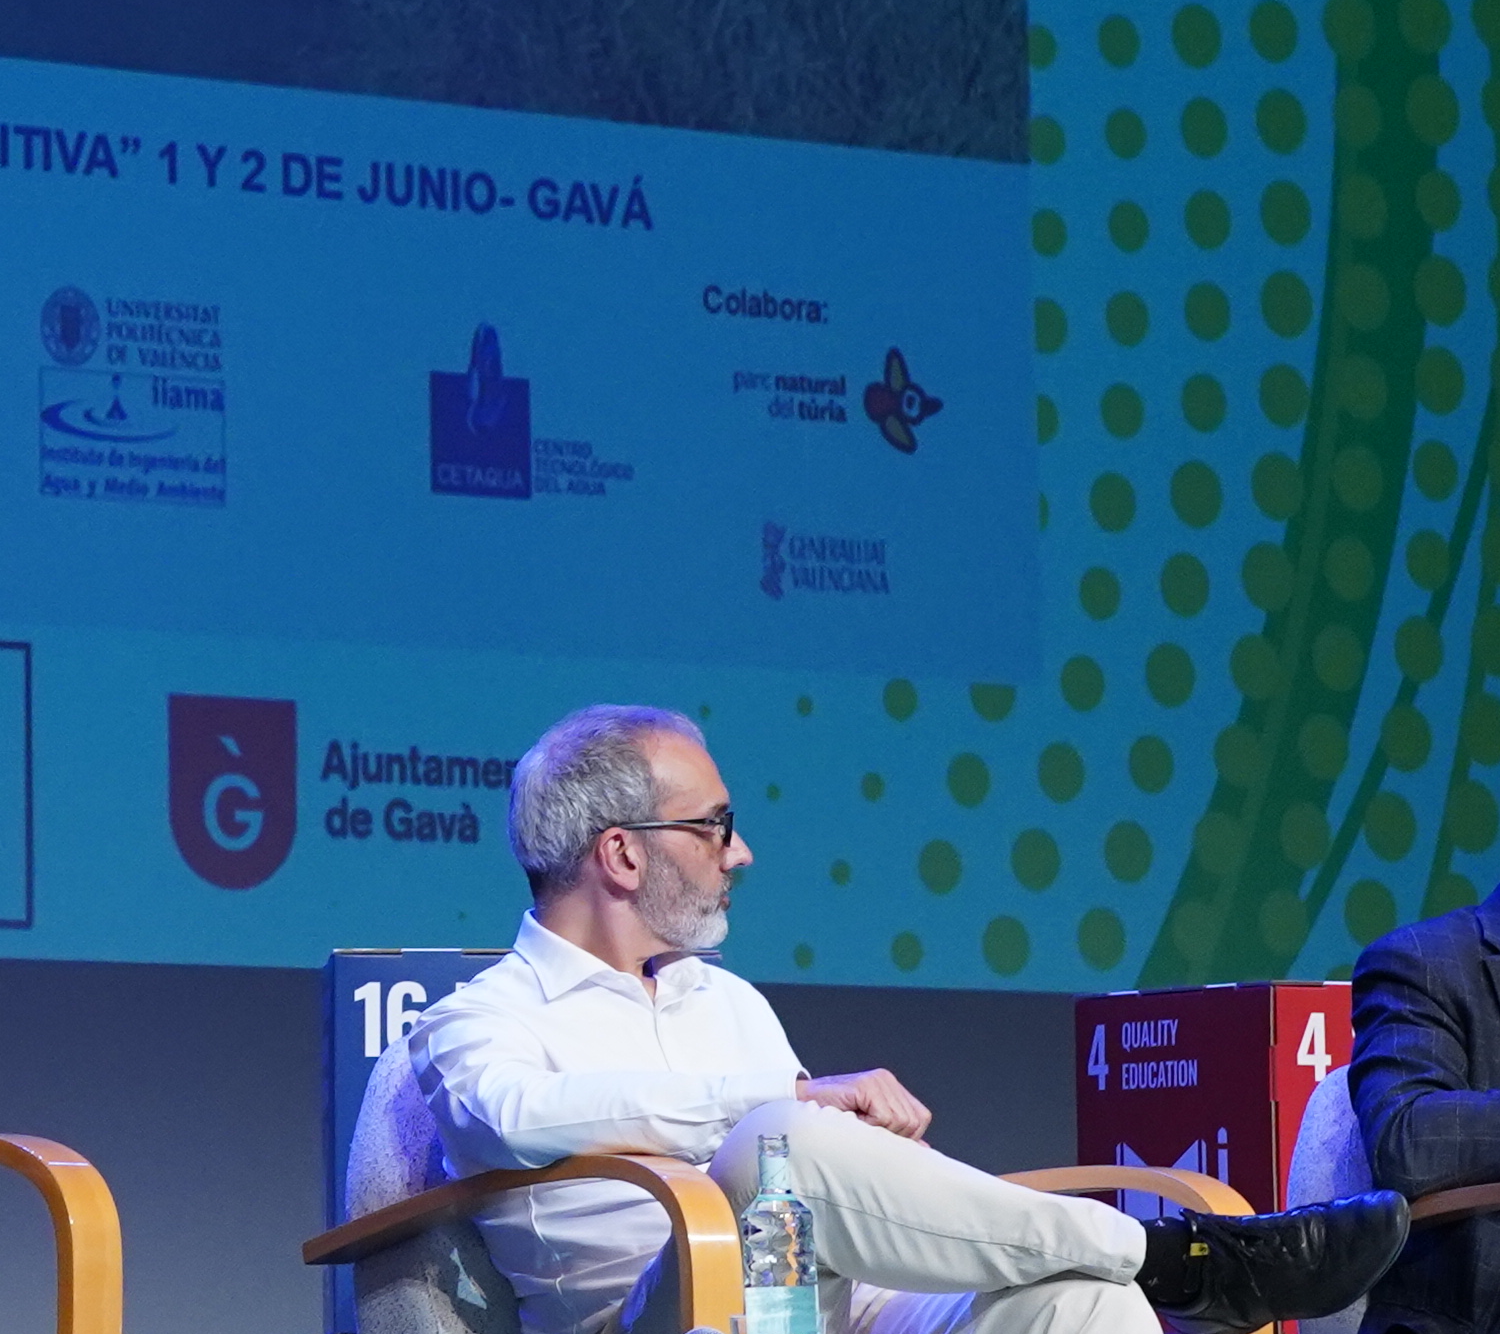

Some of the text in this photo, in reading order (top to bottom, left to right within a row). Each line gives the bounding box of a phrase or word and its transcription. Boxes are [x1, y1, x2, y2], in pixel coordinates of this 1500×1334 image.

[158, 140, 180, 185] 1
[197, 143, 228, 188] Y
[240, 148, 268, 192] 2
[281, 151, 344, 202] DE
[527, 174, 655, 231] GAVÁ
[702, 284, 828, 324] Colabora:
[775, 374, 847, 397] natural
[324, 798, 481, 845] de Gavà
[353, 980, 428, 1058] 16
[1296, 1011, 1332, 1082] 4
[1087, 1019, 1179, 1091] 4 QUALITY
[1121, 1057, 1198, 1092] EDUCATION
